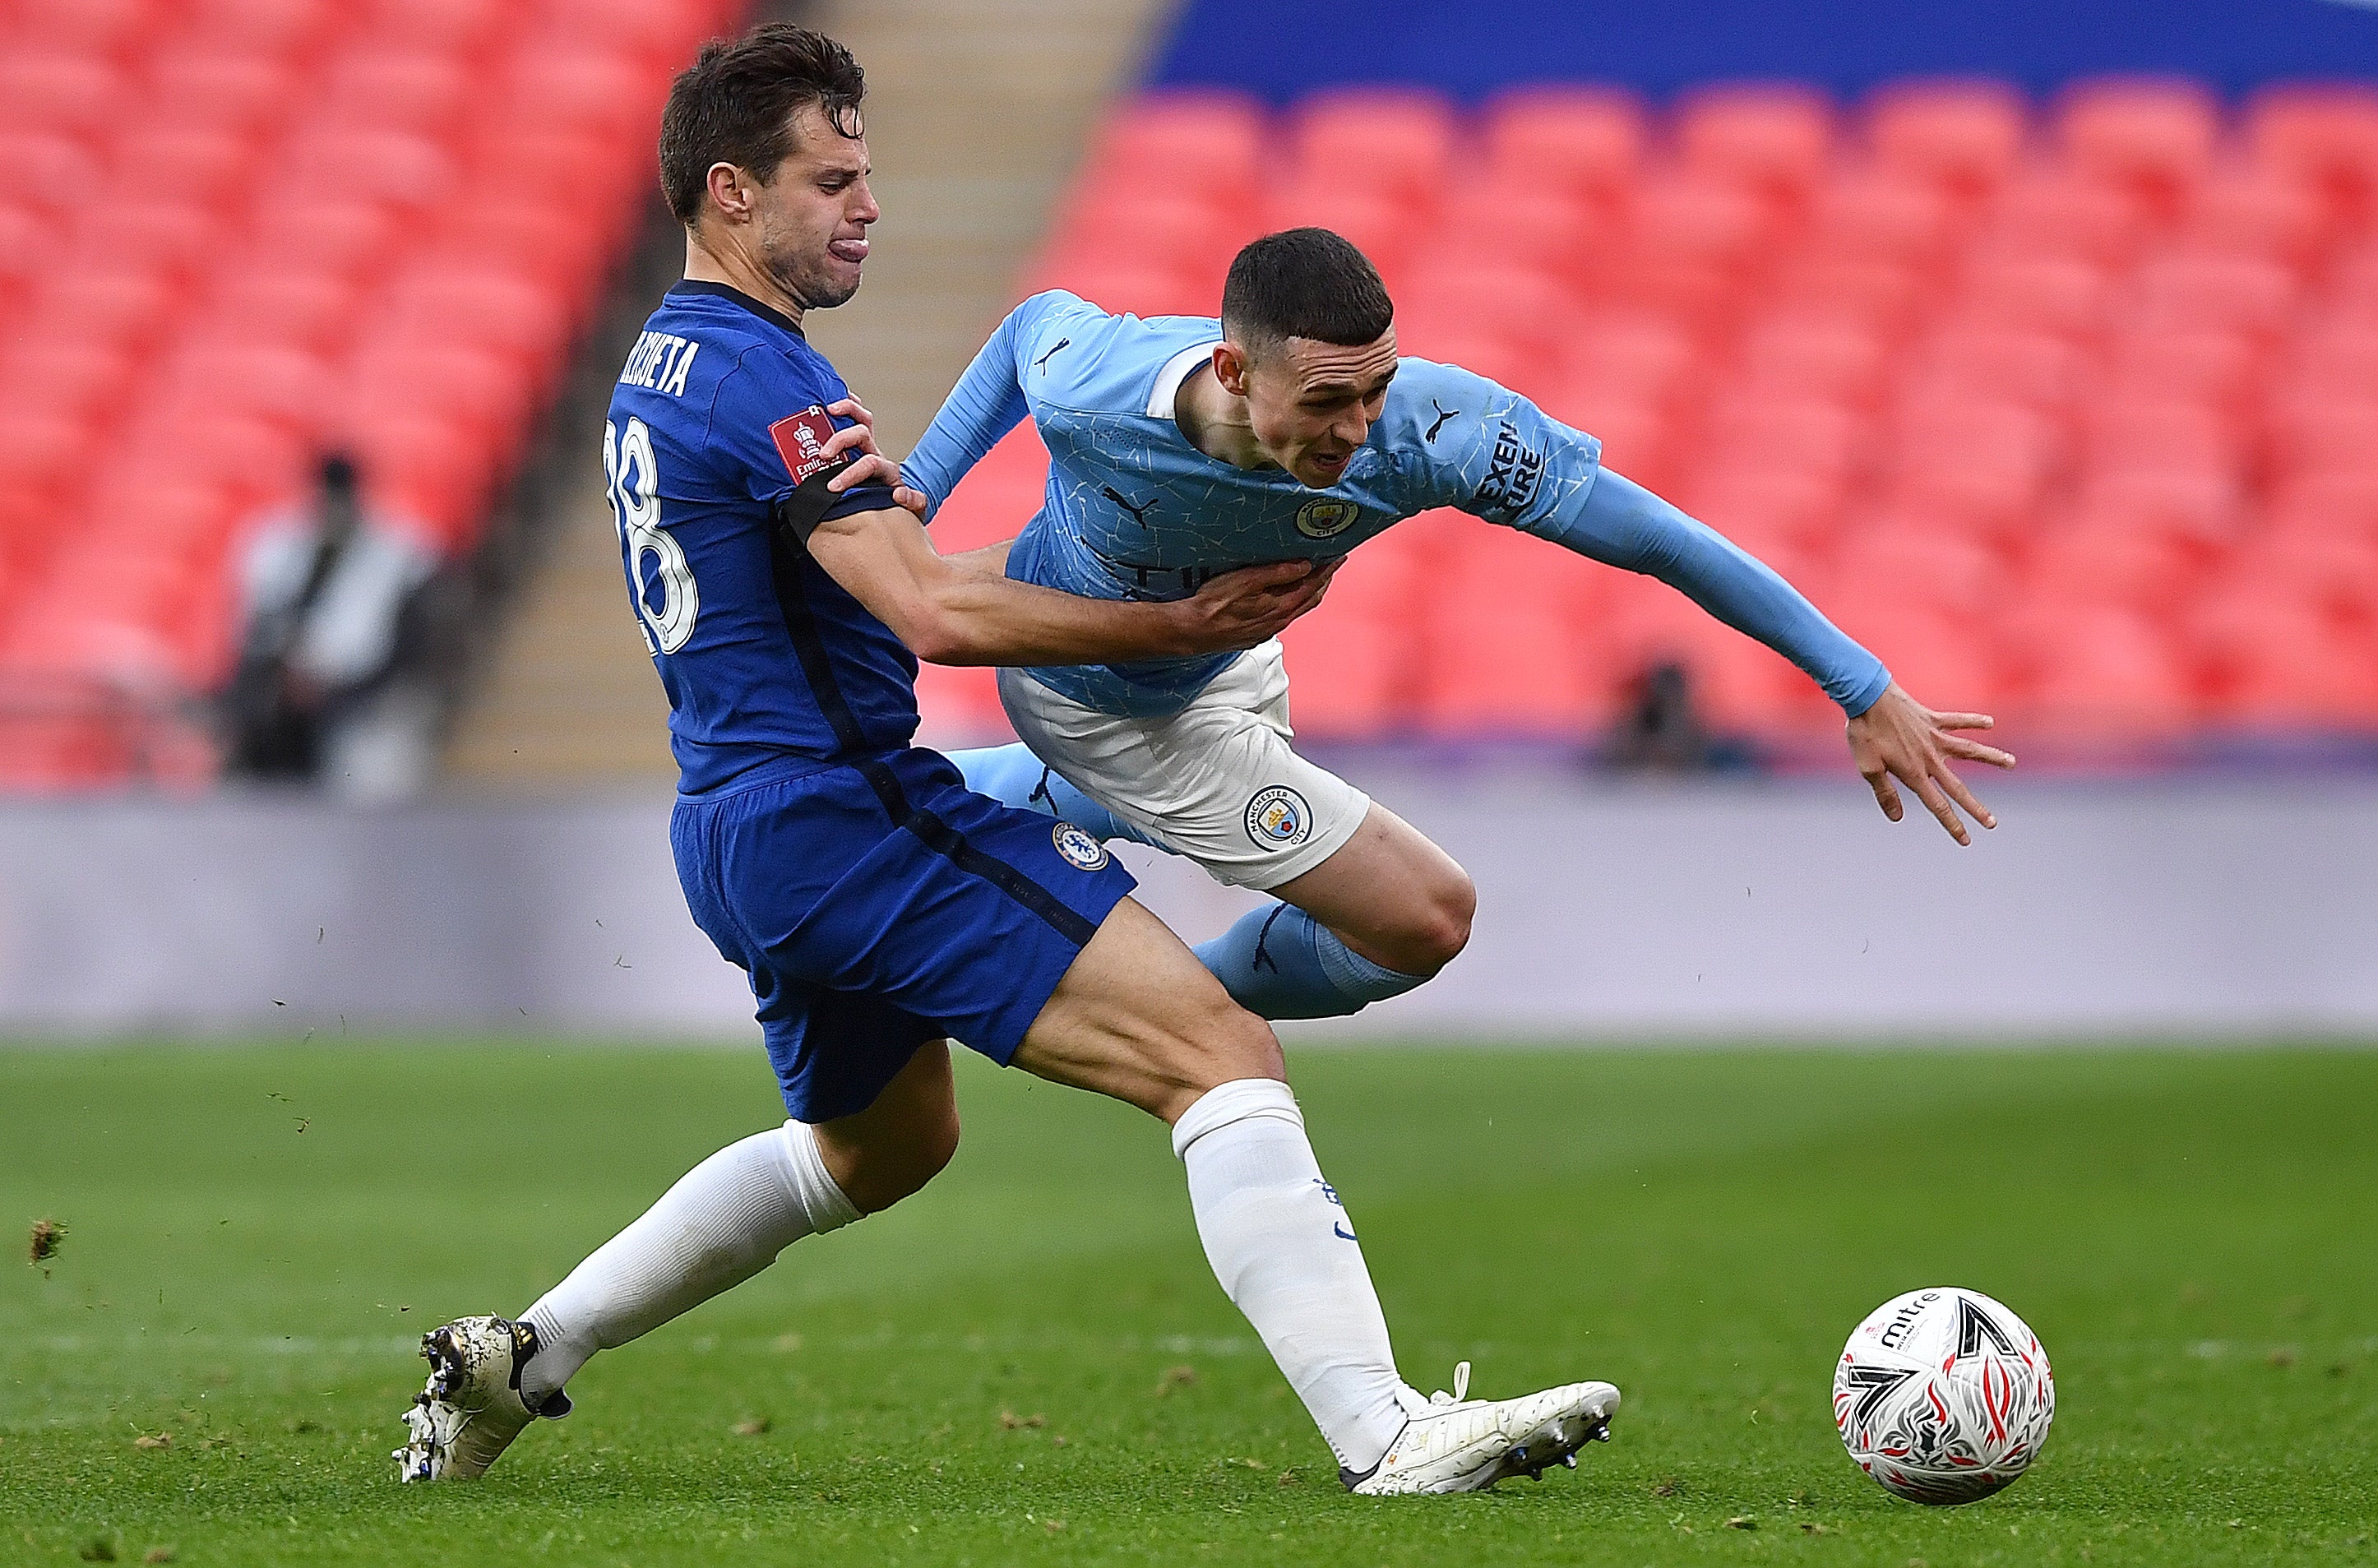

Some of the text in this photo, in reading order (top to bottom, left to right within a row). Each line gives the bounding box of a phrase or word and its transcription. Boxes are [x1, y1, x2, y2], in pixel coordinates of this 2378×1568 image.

[1474, 420, 1519, 500] EXEN
[1249, 790, 1288, 833] MANCHESTER
[1290, 827, 1307, 845] CITY
[1881, 1293, 1941, 1348] mitre
